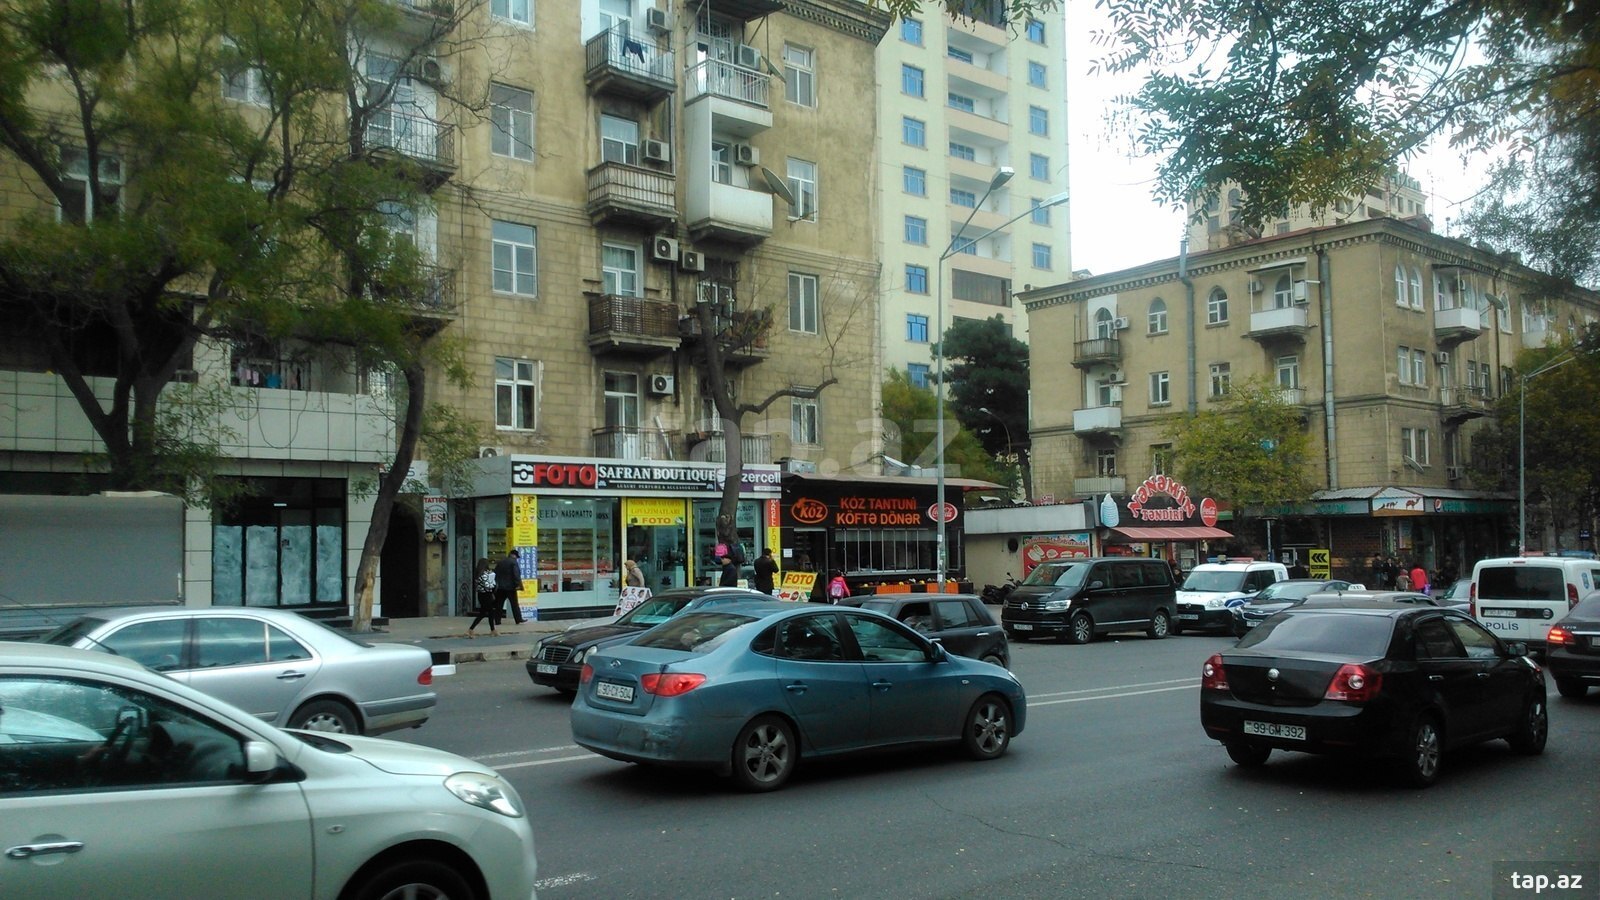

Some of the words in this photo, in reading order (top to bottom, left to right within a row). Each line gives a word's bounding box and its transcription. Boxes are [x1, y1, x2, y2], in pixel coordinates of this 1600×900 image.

[533, 464, 597, 486] FOTO
[599, 465, 650, 480] SAFRAN
[653, 467, 716, 483] BOUTIQUE
[740, 471, 781, 484] zercell
[840, 496, 865, 510] KÖZ
[870, 496, 917, 510] TANTUNİ
[836, 510, 877, 525] KÖFTƏ
[880, 511, 921, 525] DÖNƏR
[1141, 507, 1184, 521] TƏNDİRİ
[784, 573, 814, 585] FOTO
[1485, 621, 1519, 631] POLİS
